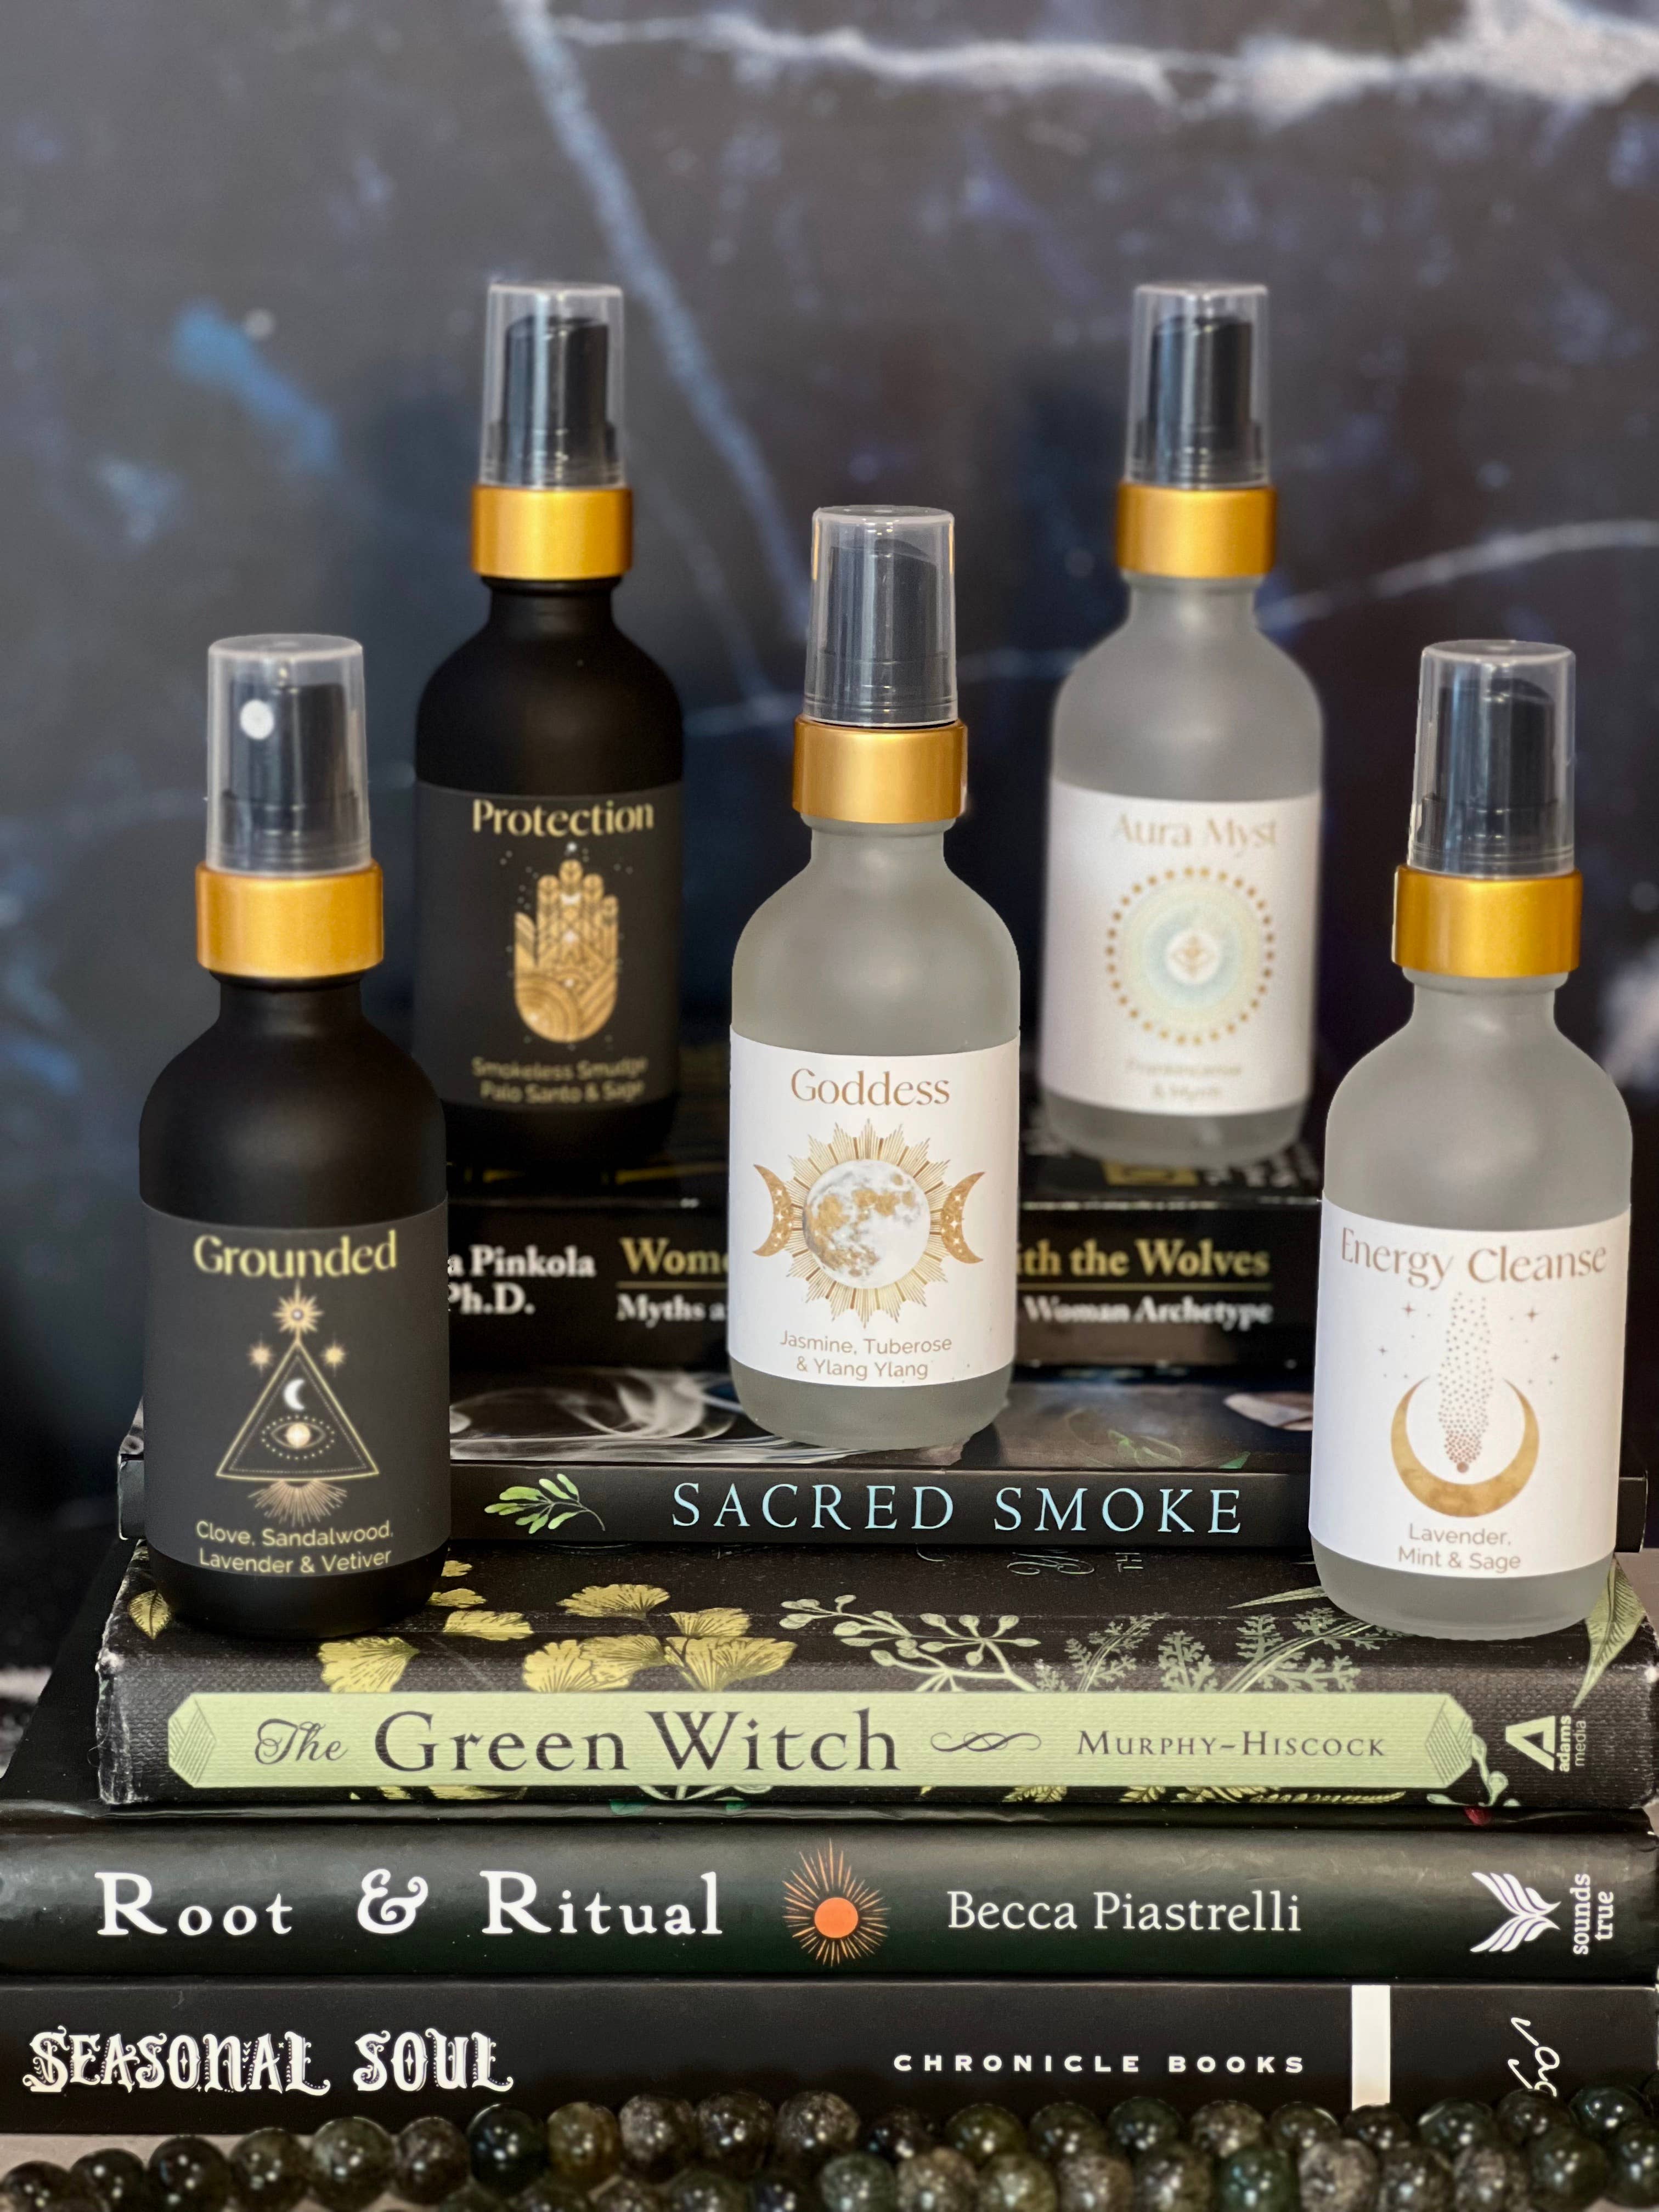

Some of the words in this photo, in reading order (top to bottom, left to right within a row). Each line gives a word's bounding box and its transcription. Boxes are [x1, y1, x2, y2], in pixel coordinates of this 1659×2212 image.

[473, 799, 654, 837] Protection
[1112, 814, 1192, 848] Aura
[1206, 817, 1277, 858] Myst
[791, 1068, 950, 1107] Goddess
[193, 1229, 397, 1279] Grounded
[469, 1243, 597, 1278] Pinkola
[1069, 1238, 1130, 1277] the
[1135, 1238, 1271, 1277] Wolves
[1342, 1227, 1454, 1290] Energy
[1468, 1245, 1607, 1283] Cleanse
[617, 1293, 706, 1328] Myths
[1023, 1294, 1132, 1323] Woman
[1133, 1294, 1274, 1332] Archetype
[780, 1330, 857, 1355] Jasmine,
[864, 1338, 952, 1355] Tuberose
[796, 1358, 808, 1372] &
[814, 1359, 868, 1380] Ylang
[874, 1361, 928, 1380] Ylang
[672, 1482, 954, 1531] SACRED
[994, 1487, 1242, 1534] SMOKE
[196, 1520, 256, 1547] Clove,
[262, 1519, 394, 1547] Sandalwood,
[1408, 1523, 1512, 1547] Lavender,
[199, 1547, 294, 1573] Lavender
[300, 1555, 315, 1573] &
[321, 1550, 392, 1572] Vetiver
[1398, 1546, 1442, 1568] Mint
[1448, 1552, 1463, 1569] &
[1469, 1551, 1521, 1574] Sage
[254, 1718, 348, 1765] The
[375, 1710, 630, 1772] Green
[646, 1707, 901, 1771] Witch
[1556, 1714, 1572, 1773] adams
[1572, 1720, 1587, 1767] media
[94, 1872, 293, 1936] Root
[357, 1868, 428, 1934] &
[479, 1870, 723, 1936] Ritual
[947, 1891, 1078, 1930] Becca
[1093, 1890, 1301, 1932] Piastrelli
[1570, 1873, 1591, 1955] sounds
[1594, 1891, 1615, 1942] true
[22, 2025, 331, 2096] SEASONAL
[353, 2027, 514, 2092] SOUL
[893, 2054, 1139, 2073] CHRONICLE
[1169, 2055, 1304, 2074] BOOKS
